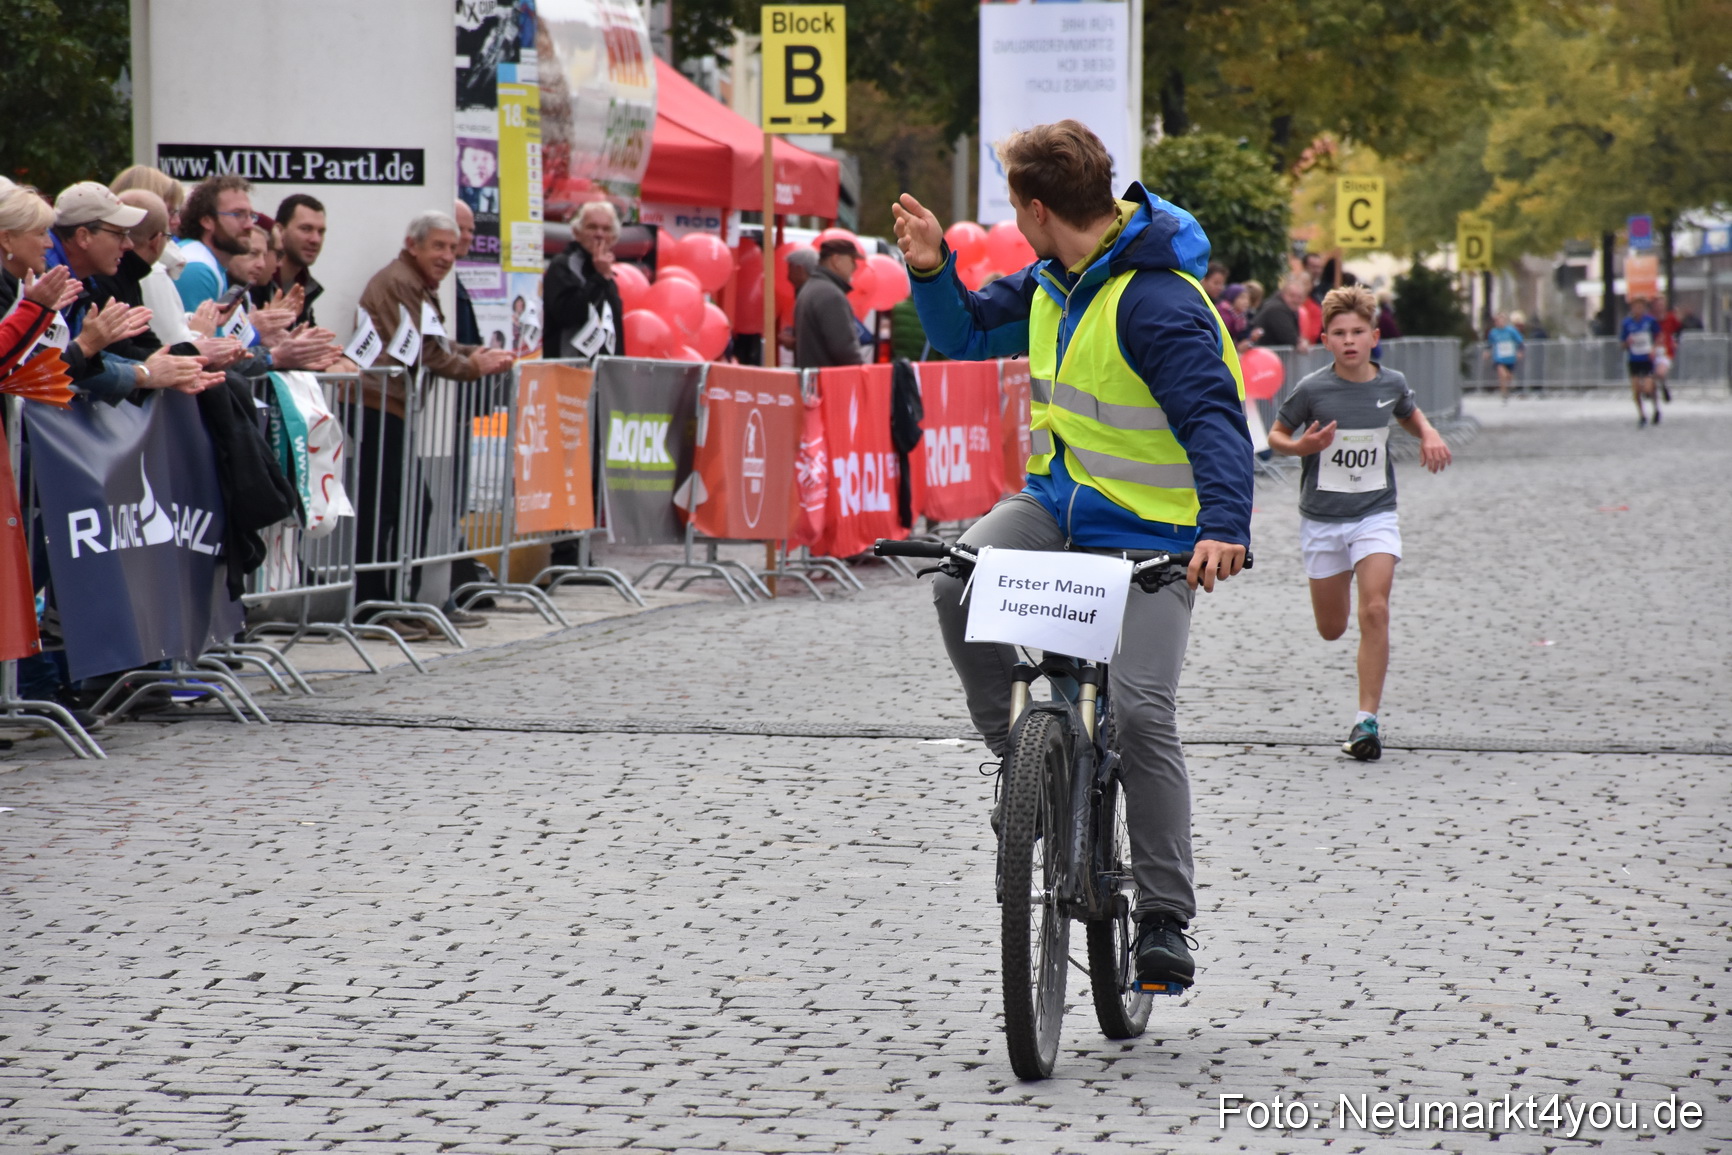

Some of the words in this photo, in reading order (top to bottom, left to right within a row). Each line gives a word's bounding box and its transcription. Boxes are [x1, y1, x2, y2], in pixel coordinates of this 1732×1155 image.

[772, 12, 835, 33] Block
[785, 45, 824, 104] B
[159, 151, 414, 181] www.MINI-Partl.de
[1343, 181, 1378, 193] Block
[1348, 198, 1372, 231] C
[1466, 236, 1482, 259] D
[356, 328, 375, 359] swn
[399, 328, 414, 356] swn
[607, 418, 671, 464] BOCK
[1331, 448, 1378, 468] 4001
[998, 575, 1050, 592] Erster
[1054, 579, 1107, 598] Mann
[999, 599, 1098, 625] Jugendlauf
